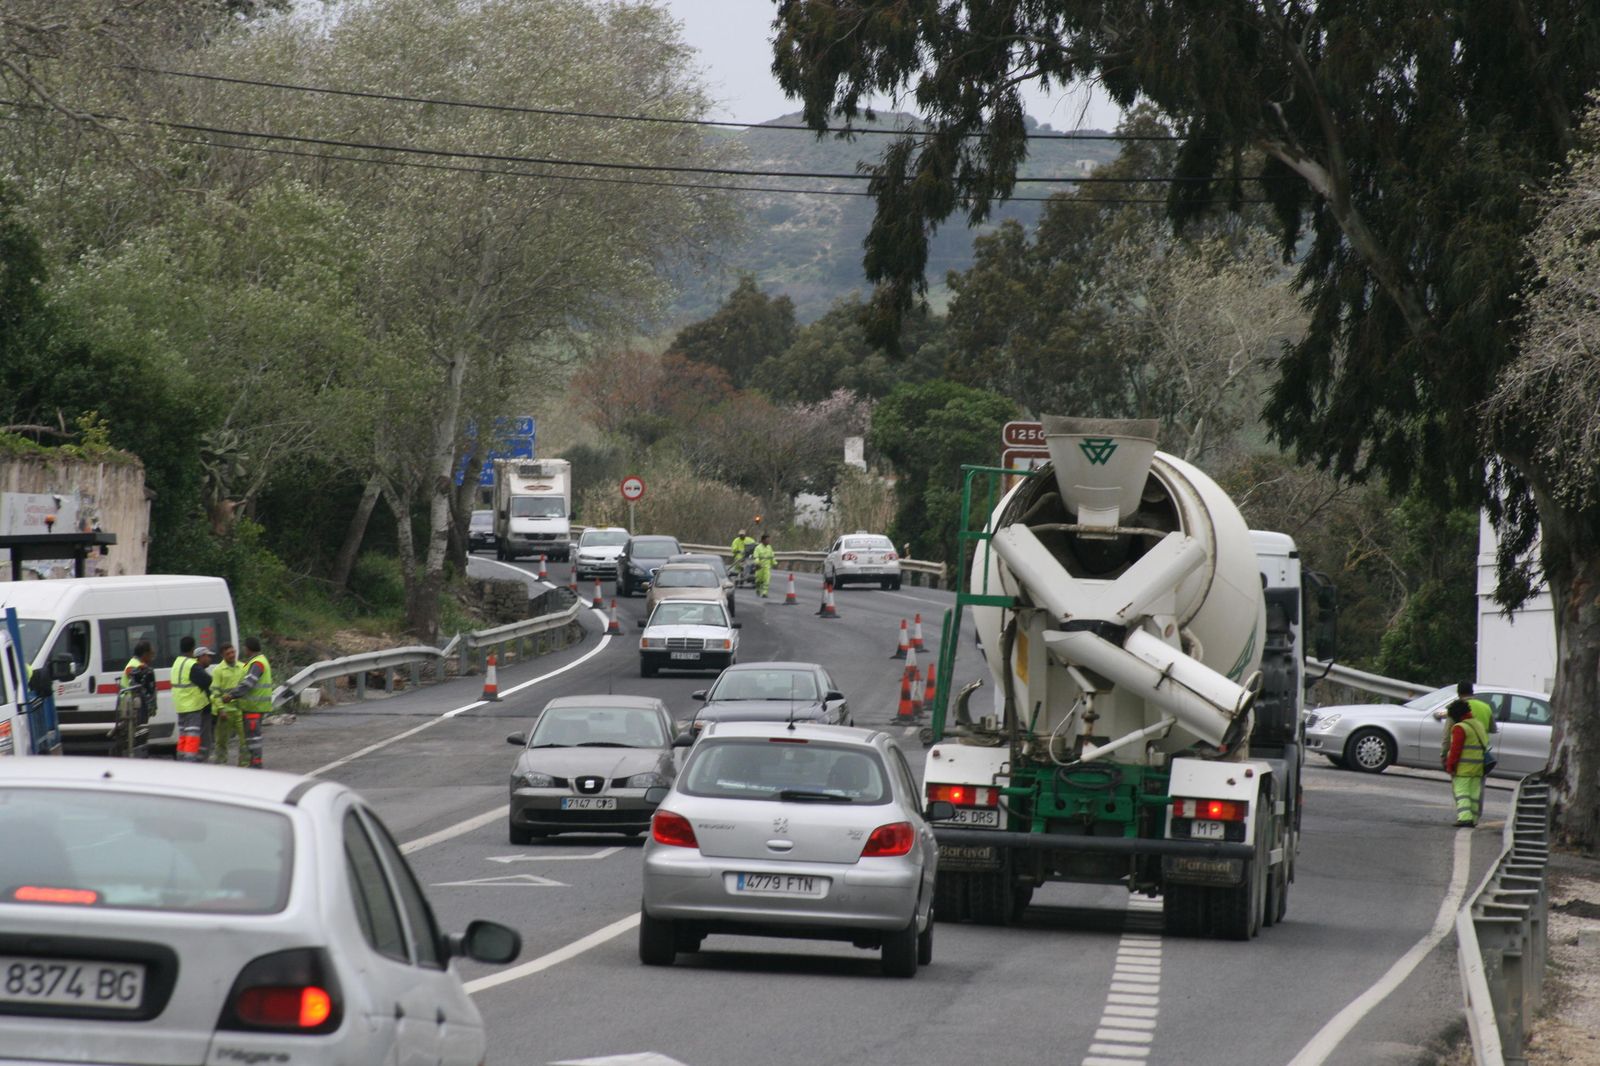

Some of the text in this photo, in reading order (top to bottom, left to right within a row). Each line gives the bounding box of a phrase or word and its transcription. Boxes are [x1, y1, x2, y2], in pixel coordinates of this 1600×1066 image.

[567, 799, 590, 809] 7147
[971, 811, 994, 824] DRS
[747, 871, 814, 892] 4779 FTN
[5, 963, 138, 1002] 8374 BG
